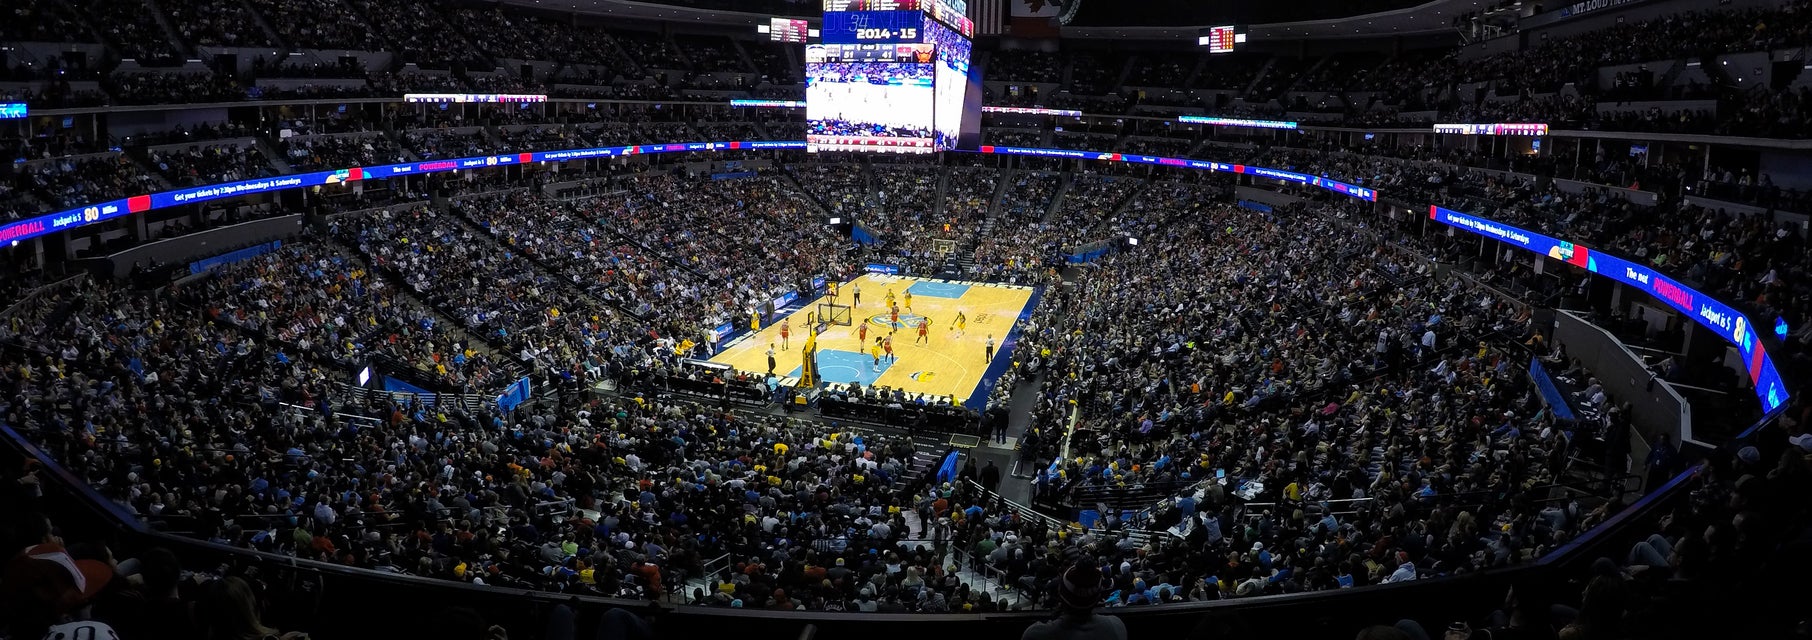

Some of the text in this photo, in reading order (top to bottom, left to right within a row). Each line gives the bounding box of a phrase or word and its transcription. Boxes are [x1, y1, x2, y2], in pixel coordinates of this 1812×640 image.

[1586, 0, 1609, 11] LOUD
[856, 28, 891, 39] 2014
[900, 28, 917, 39] 15
[419, 161, 457, 170] POWERBALL
[487, 156, 497, 165] 80
[185, 193, 196, 201] your
[213, 188, 219, 196] by
[236, 182, 269, 191] Wednesdays
[276, 178, 301, 186] Saturdays
[54, 217, 72, 226] Jackpot
[84, 207, 99, 221] 80
[1470, 219, 1473, 228] by
[1486, 223, 1506, 238] Wednesdays
[1510, 231, 1529, 245] Saturdays
[1626, 267, 1637, 280] The
[1638, 273, 1648, 284] next
[1654, 277, 1693, 311] POWERBALL
[1700, 303, 1720, 325] Jackpot
[1720, 313, 1725, 328] is
